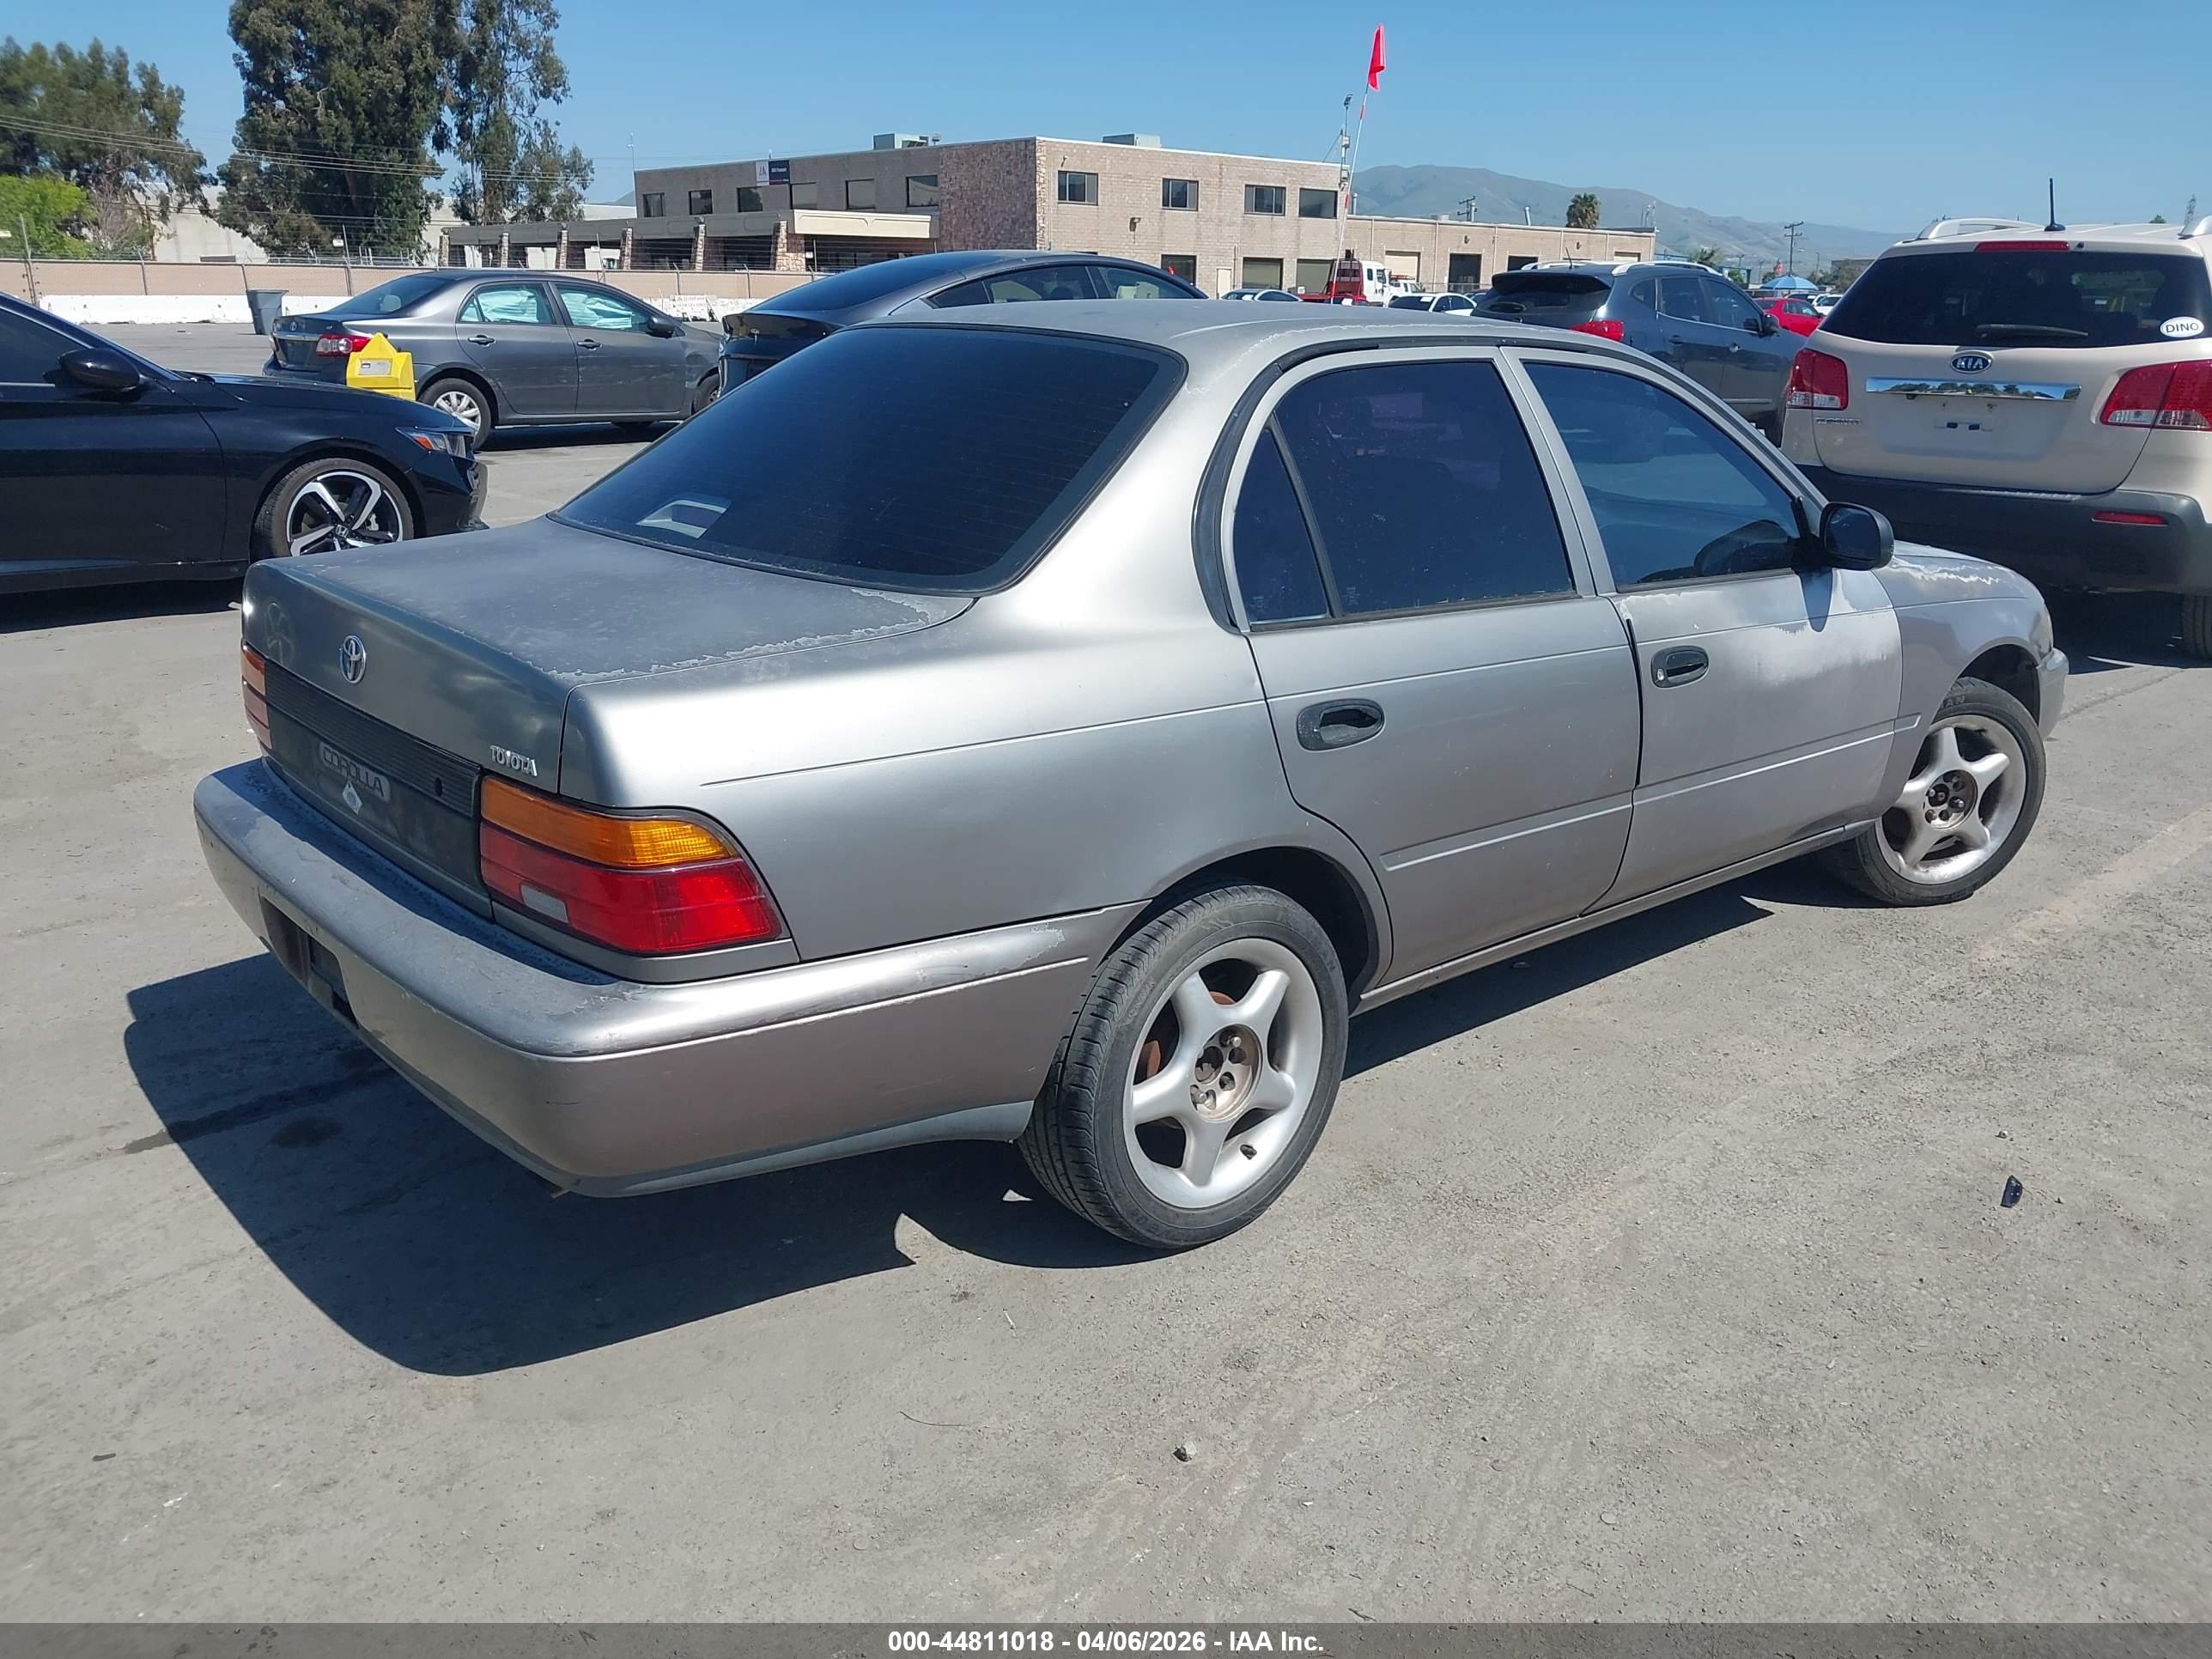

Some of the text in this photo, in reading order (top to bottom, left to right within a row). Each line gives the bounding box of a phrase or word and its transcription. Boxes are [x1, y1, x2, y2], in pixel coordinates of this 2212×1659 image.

[2166, 323, 2199, 333] DINO
[1956, 357, 1984, 369] KIA
[490, 744, 538, 777] TOYOTA
[322, 746, 385, 798] COROLLA
